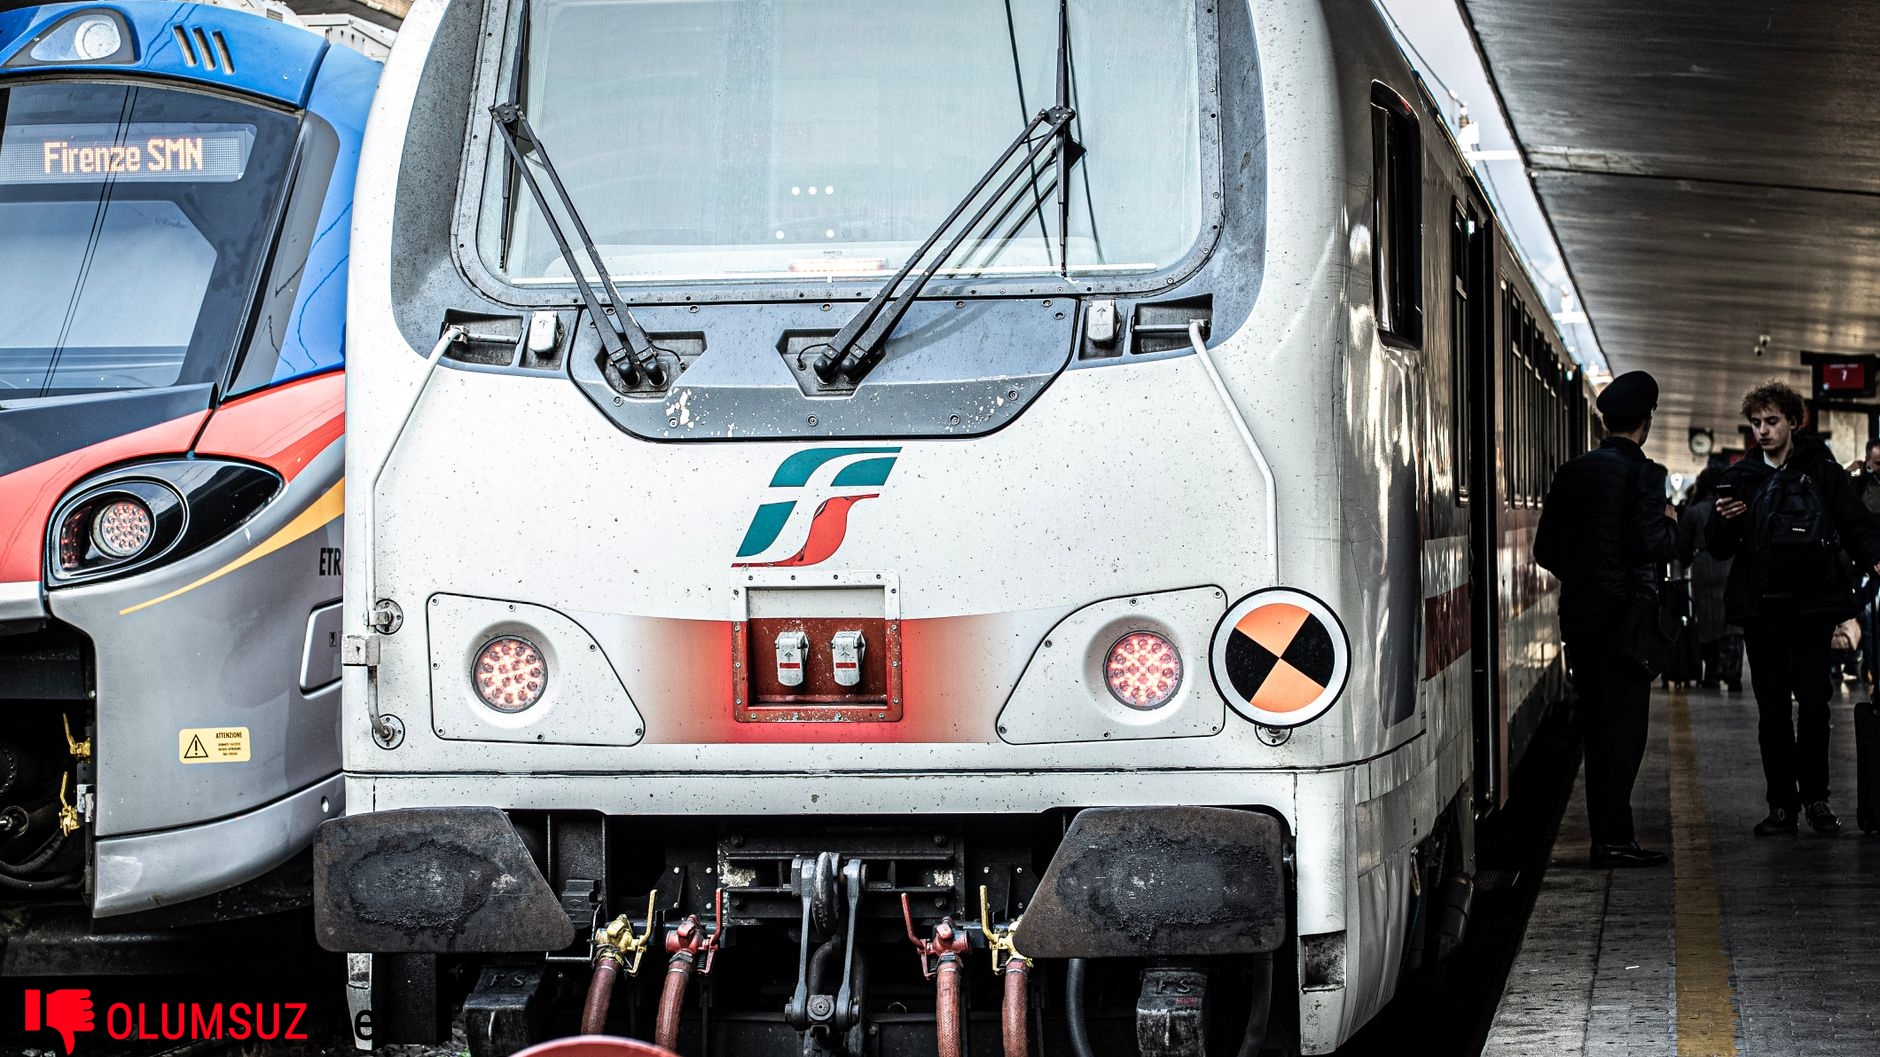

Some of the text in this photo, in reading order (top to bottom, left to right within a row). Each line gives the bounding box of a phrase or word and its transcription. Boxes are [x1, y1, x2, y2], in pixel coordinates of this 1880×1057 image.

[44, 137, 203, 173] Firenze SMN
[319, 547, 341, 576] ETR
